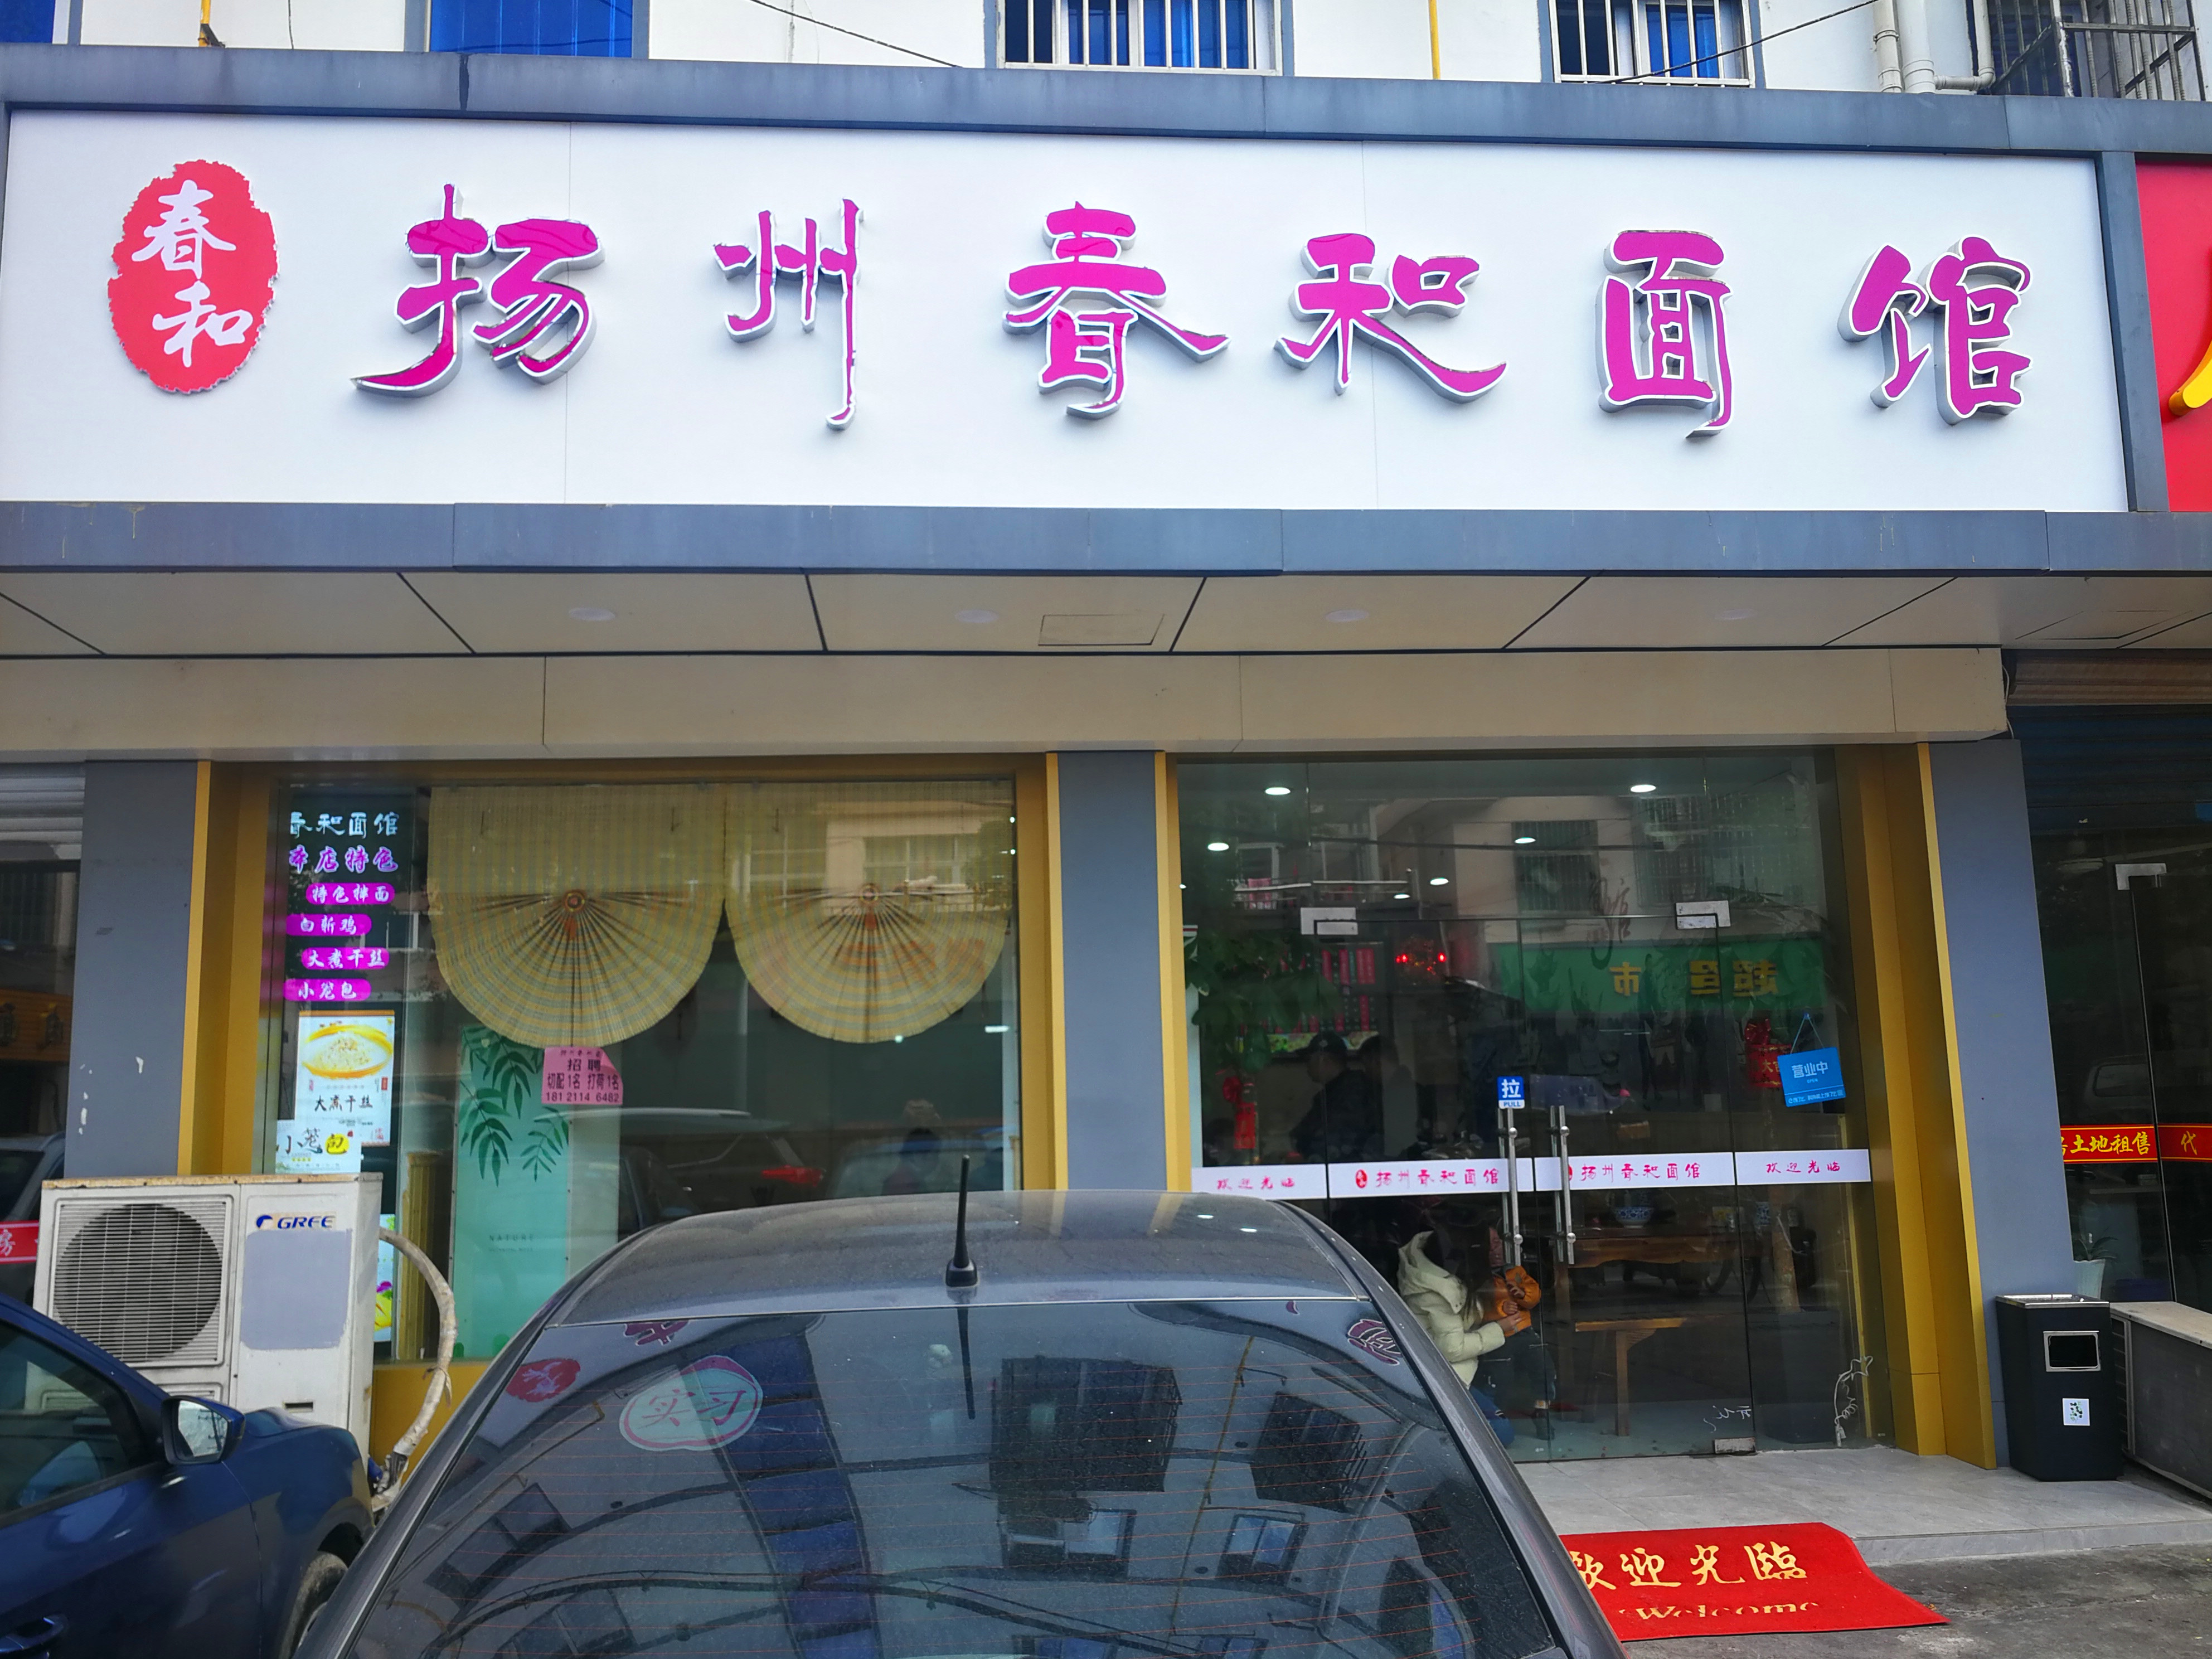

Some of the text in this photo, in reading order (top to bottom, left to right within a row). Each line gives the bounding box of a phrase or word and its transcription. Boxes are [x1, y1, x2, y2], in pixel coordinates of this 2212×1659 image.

[132, 180, 253, 367] 春和
[351, 184, 2032, 436] 扬州春和面馆
[289, 845, 399, 874] 本店特色
[300, 914, 357, 935] 白斩鸡
[307, 949, 385, 969] 大煮干丝
[298, 981, 357, 1000] 小笼包
[567, 1059, 600, 1071] 招聘
[1792, 1061, 1828, 1078] 营业中
[1501, 1079, 1521, 1098] 拉
[314, 1094, 372, 1112] 大煮干丝
[2181, 1131, 2198, 1156] 代
[1581, 1163, 1700, 1182] 扬州春和面馆
[1766, 1160, 1840, 1173] 欢迎光临
[1376, 1168, 1500, 1189] 扬州春和面馆
[277, 1215, 336, 1229] GREE
[638, 1389, 746, 1426] 实习
